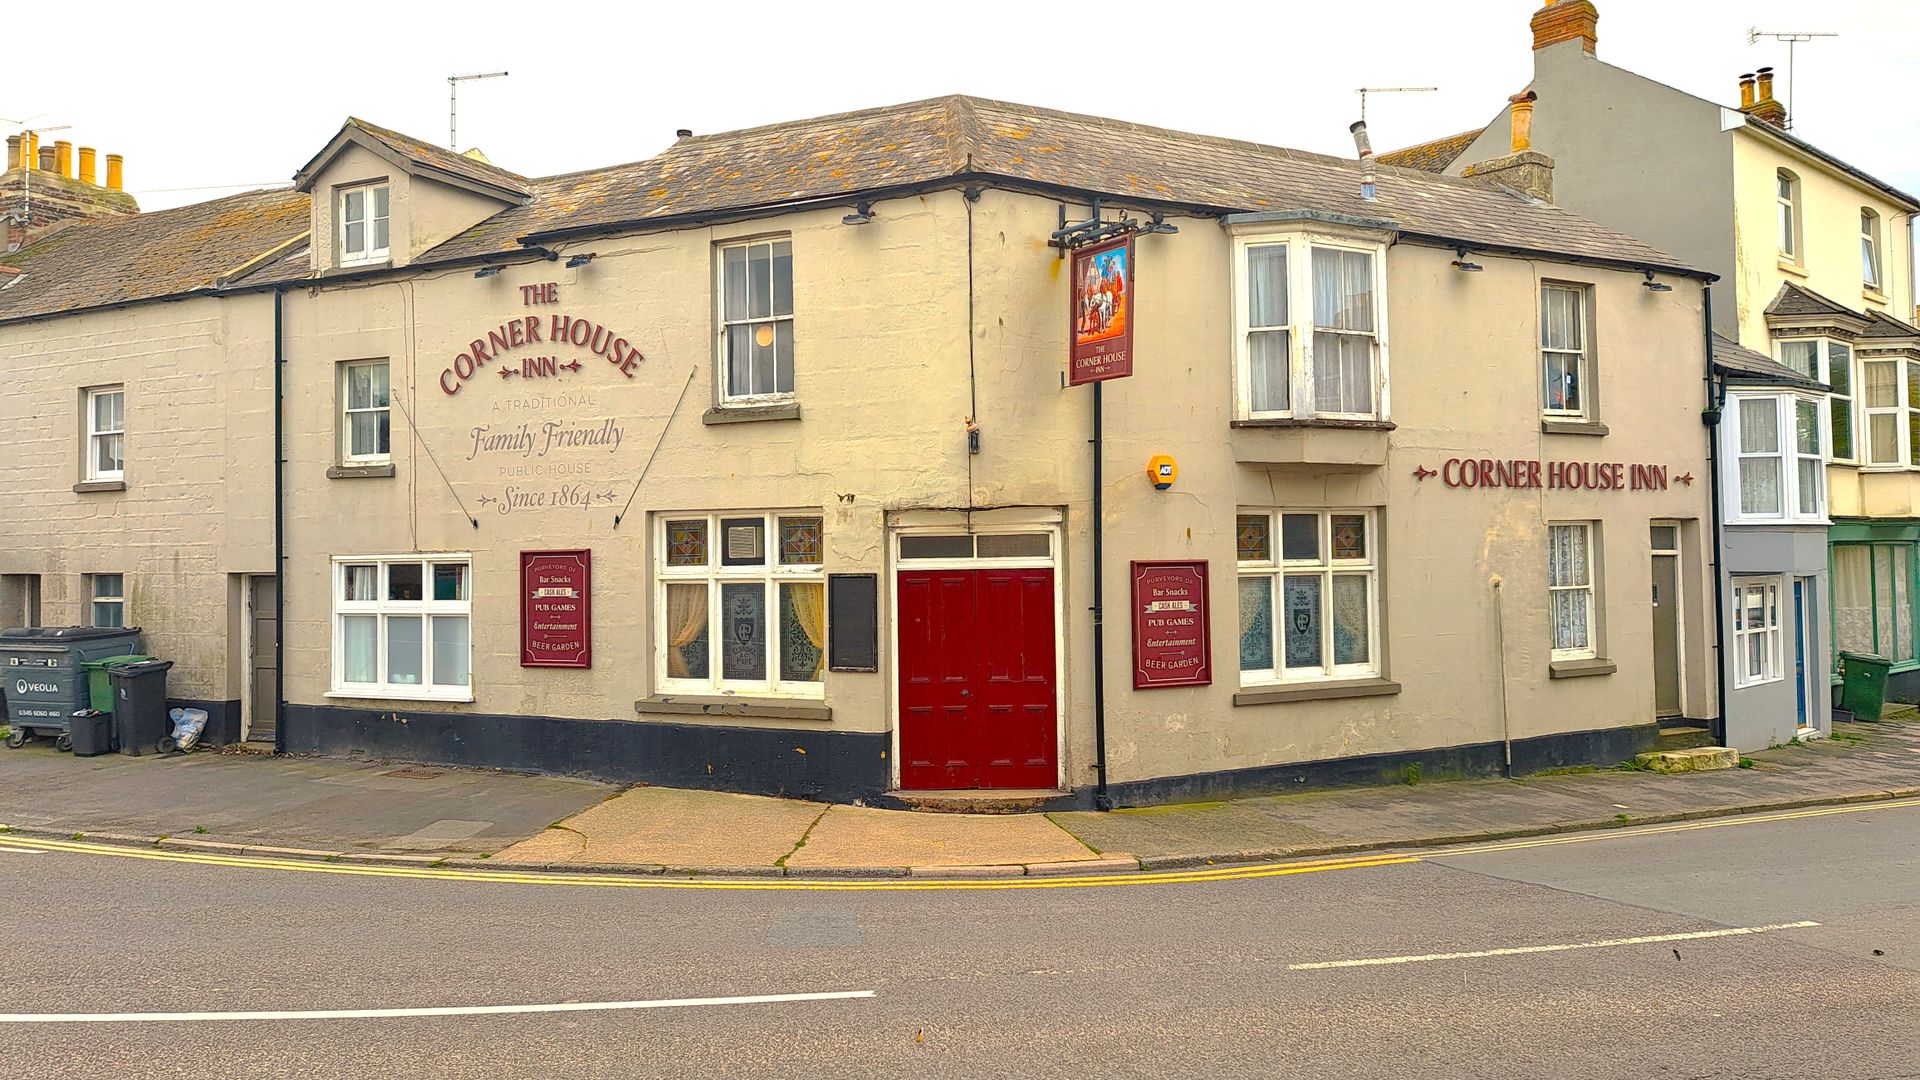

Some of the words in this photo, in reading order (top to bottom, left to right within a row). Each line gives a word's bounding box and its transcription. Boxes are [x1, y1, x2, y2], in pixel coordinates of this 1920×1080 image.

[520, 282, 559, 305] THE
[1095, 345, 1106, 353] THE
[440, 316, 542, 395] CORNER
[549, 314, 644, 379] HOUSE
[1076, 355, 1102, 369] CORNER
[1103, 350, 1126, 364] HOUSE
[521, 356, 556, 379] INN
[1095, 365, 1105, 373] INN
[492, 401, 500, 412] A
[505, 394, 596, 410] TRADITIONAL
[466, 422, 536, 460] Family
[538, 417, 624, 457] Friendly
[500, 465, 544, 476] PUBLIC
[549, 462, 591, 475] HOUSE
[1160, 466, 1172, 475] ADT
[1444, 458, 1543, 489] CORNER
[1549, 461, 1625, 490] HOUSE
[1631, 463, 1668, 490] INN
[498, 485, 545, 515] Since
[551, 484, 592, 511] 1864
[534, 564, 567, 572] PURVEYORS
[550, 575, 571, 583] Snacks
[1146, 575, 1183, 584] PURVEYORS
[544, 588, 554, 596] CASK
[556, 588, 567, 596] ALES
[1165, 588, 1188, 596] Snacks
[1172, 601, 1183, 609] ALES
[533, 621, 577, 630] Entertainment
[1148, 619, 1164, 627] PUB
[1166, 618, 1194, 626] GAMES
[532, 640, 550, 651] BEER
[551, 641, 580, 651] GARDEN
[1146, 637, 1196, 647] Entertainment
[1145, 659, 1166, 669] BEER
[1168, 656, 1199, 669] GARDEN
[28, 683, 59, 692] VEOLIA
